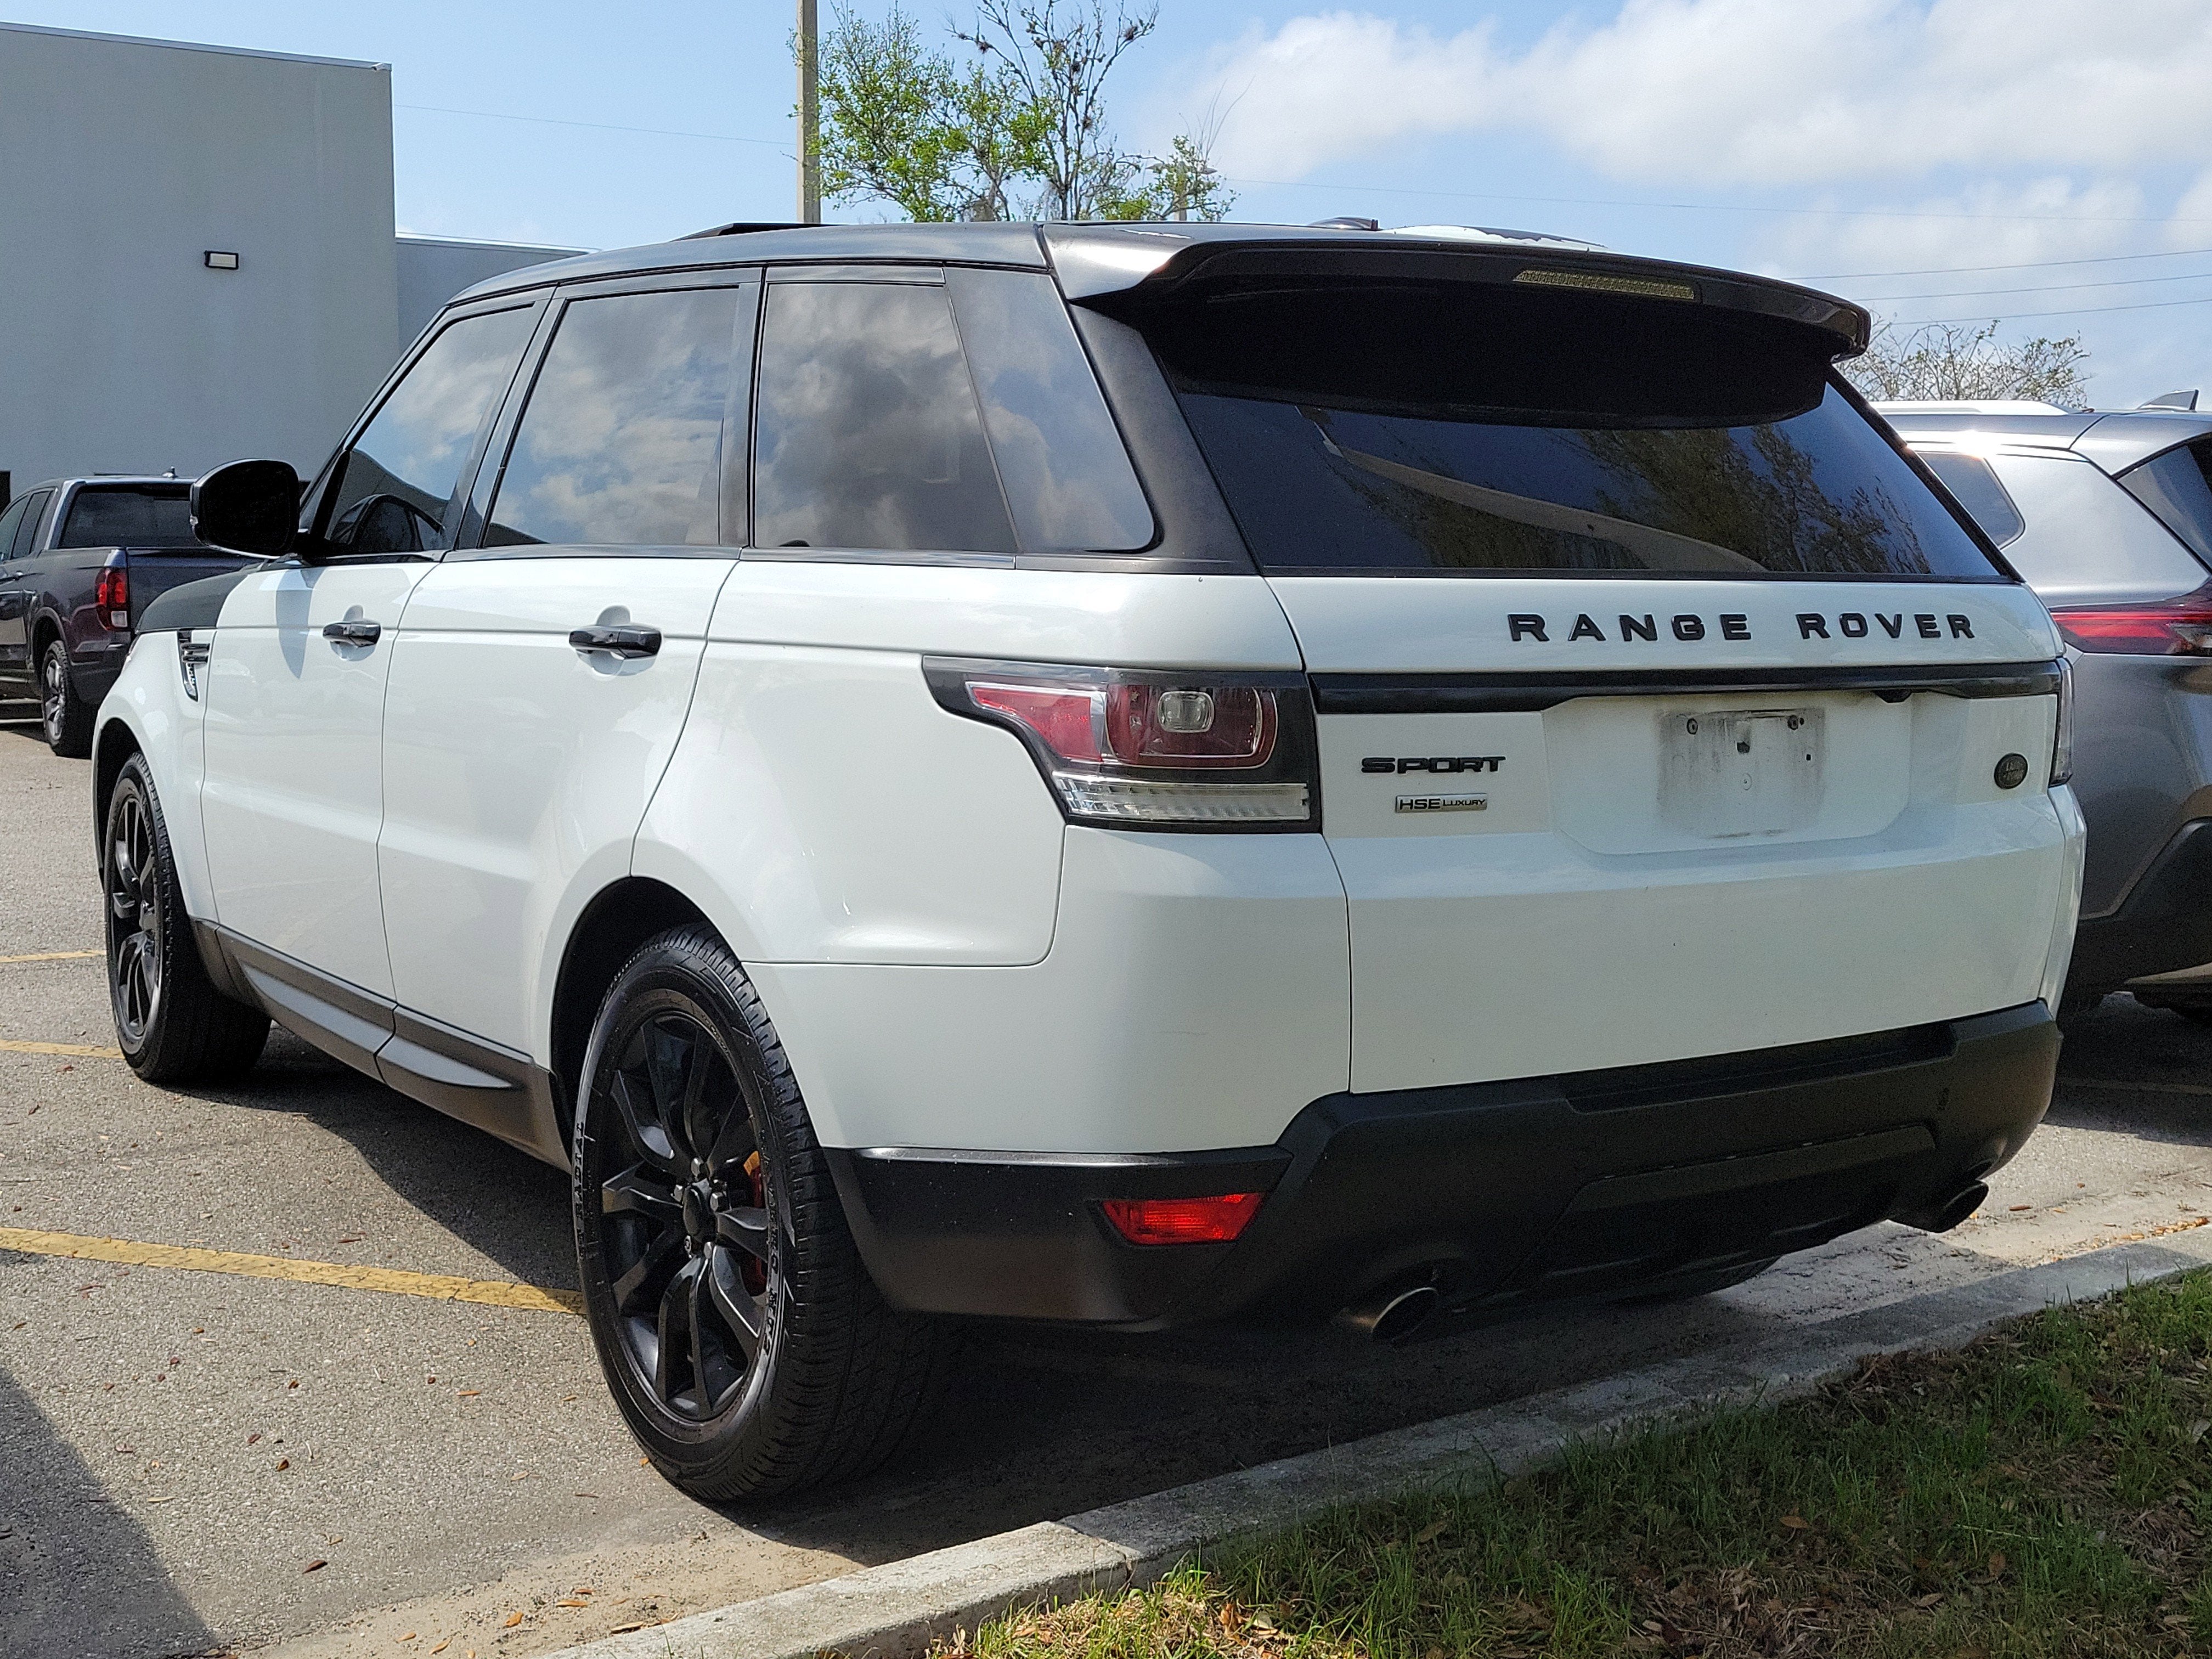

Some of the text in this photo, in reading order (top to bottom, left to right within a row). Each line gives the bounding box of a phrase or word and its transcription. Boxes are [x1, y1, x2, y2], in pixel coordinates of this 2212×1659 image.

[1508, 613, 1975, 642] RANGE ROVER
[1361, 756, 1506, 774] SPORT
[1400, 798, 1441, 810] HSE
